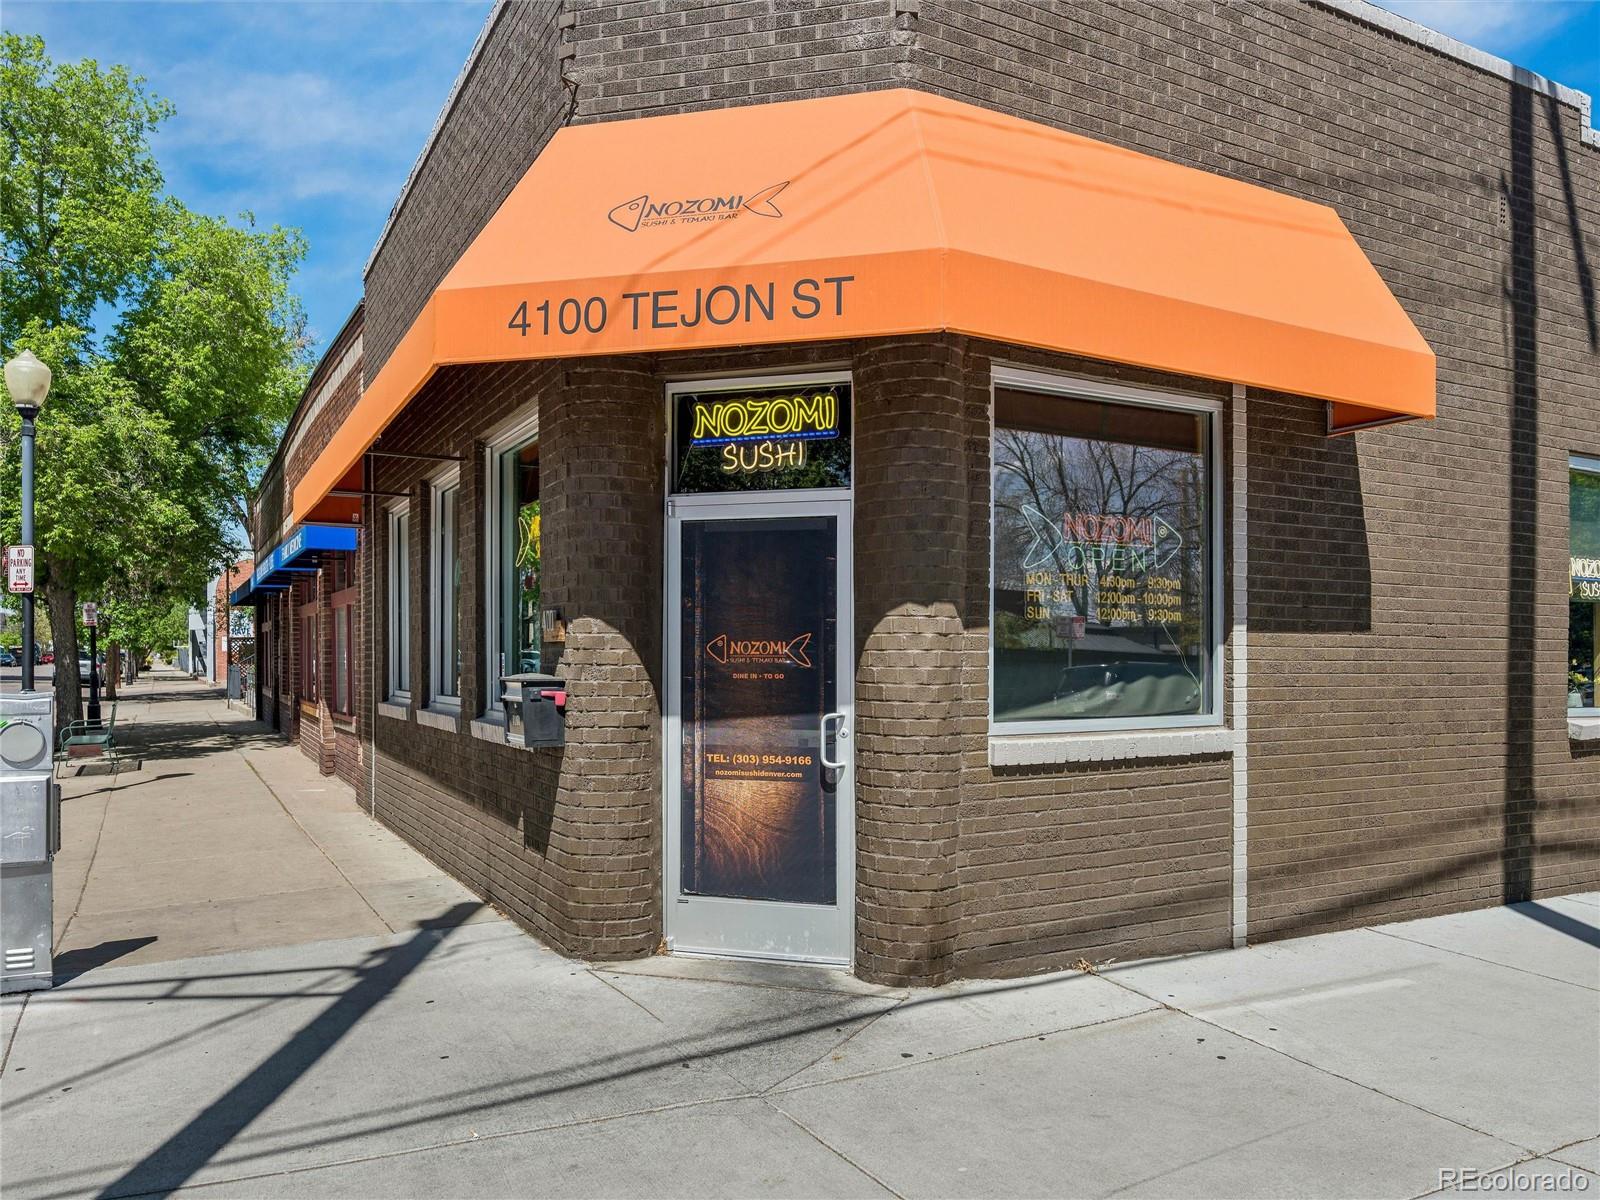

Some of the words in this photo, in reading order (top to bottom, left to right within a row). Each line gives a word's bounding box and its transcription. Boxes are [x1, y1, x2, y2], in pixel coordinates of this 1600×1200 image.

[644, 195, 743, 218] NOZOMI
[641, 219, 668, 228] SUSHI
[681, 215, 716, 225] TEMAKI
[718, 212, 739, 221] BAR
[507, 296, 608, 337] 4100
[622, 282, 775, 330] TEJON
[791, 275, 855, 320] ST
[693, 395, 836, 438] NOZOMI
[722, 440, 804, 470] SUSHI
[1063, 511, 1153, 546] NOZOMI
[10, 558, 32, 567] PARKING
[17, 549, 25, 558] NO
[1067, 545, 1146, 573] OPEN
[1026, 572, 1052, 586] MON
[1060, 573, 1089, 587] THUR
[1147, 576, 1182, 591] 9:30pm
[1026, 590, 1045, 603] FRI
[1052, 590, 1074, 603] SAT
[1096, 590, 1136, 607] 12:00pm
[1143, 592, 1182, 608] 10:00pm
[1026, 606, 1051, 620] SUN
[1096, 607, 1136, 623] 12:00pm
[1147, 609, 1182, 624] 9:30pm
[729, 640, 787, 655] NOZOMI
[706, 753, 730, 764] TEL:
[732, 754, 760, 766] (303)
[762, 755, 812, 766] 954-9166
[714, 769, 803, 779] nozomisushidenver.com
